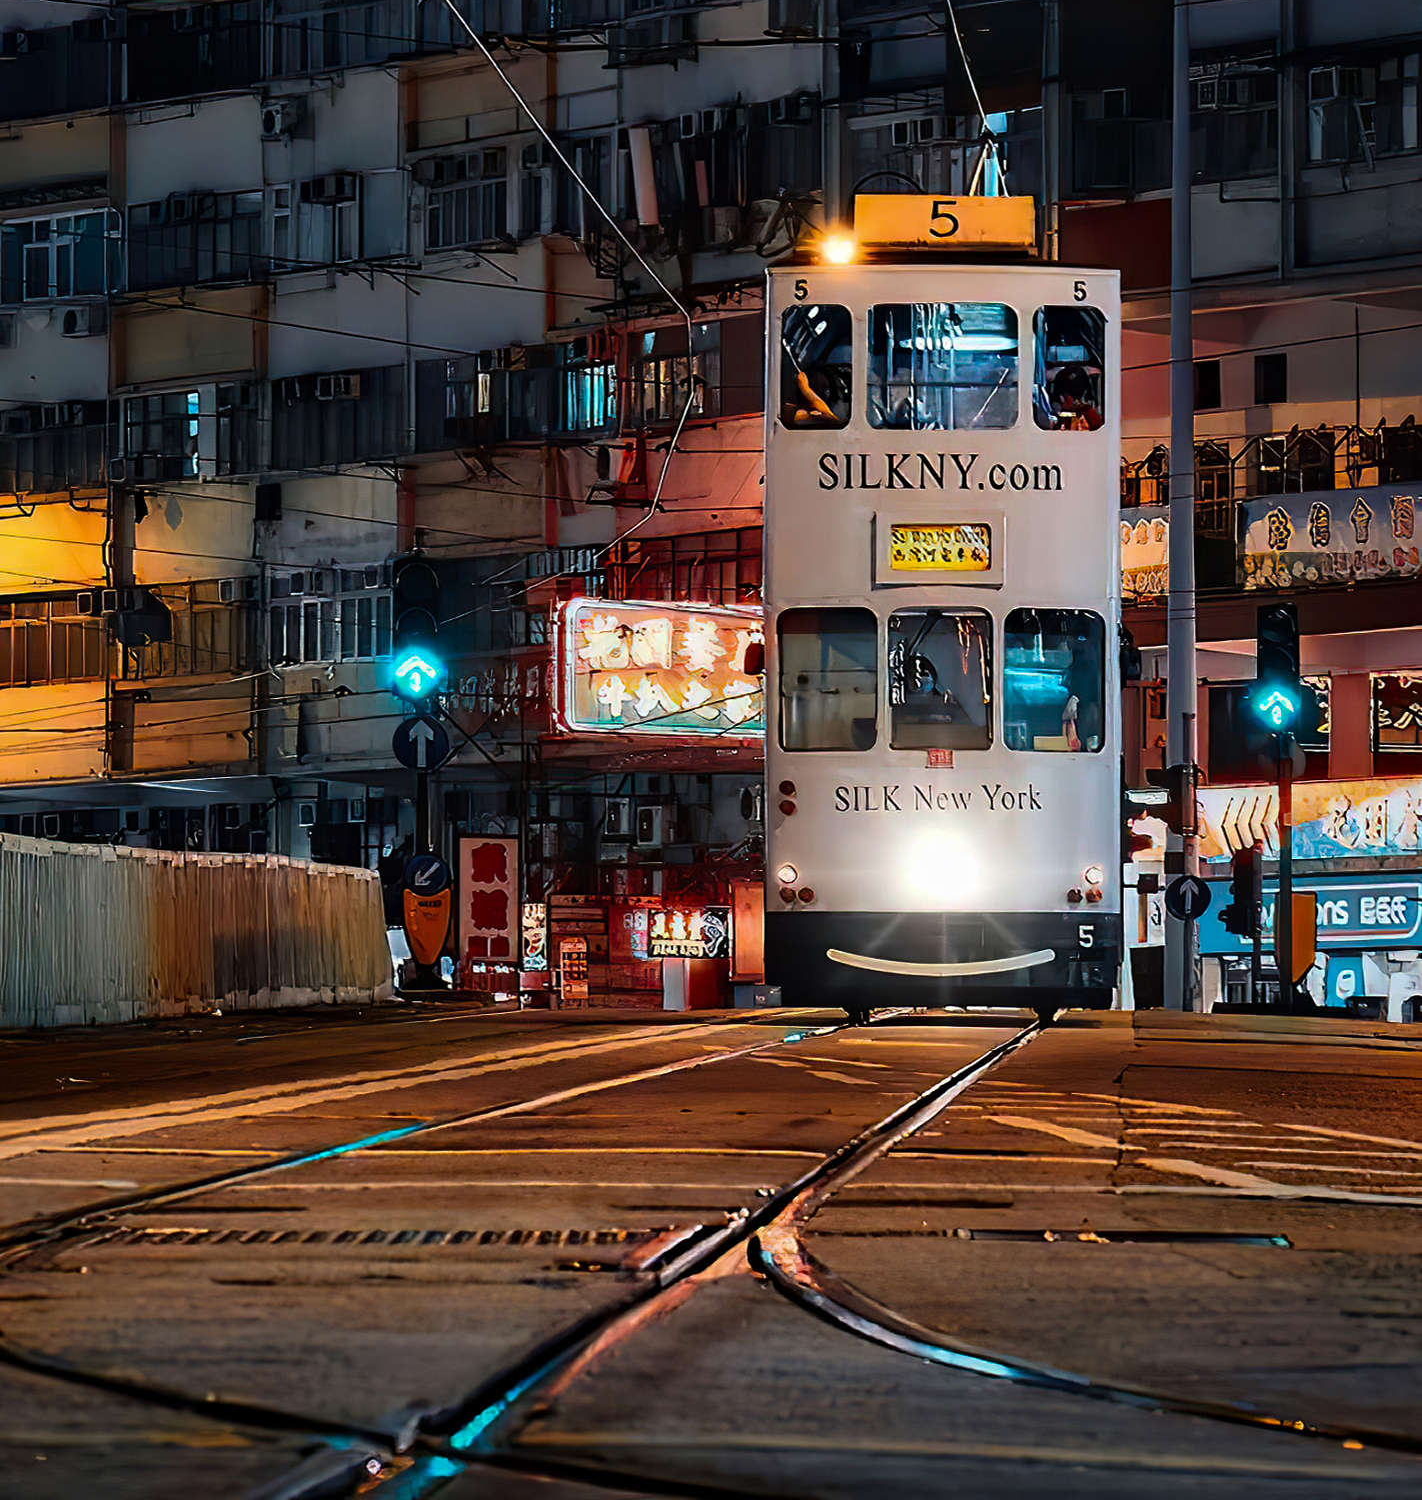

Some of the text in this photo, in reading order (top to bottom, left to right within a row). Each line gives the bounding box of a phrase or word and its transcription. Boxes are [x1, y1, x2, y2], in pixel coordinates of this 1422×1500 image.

[929, 200, 959, 238] 5
[794, 279, 809, 300] 5
[1073, 280, 1087, 302] 5
[818, 452, 1062, 491] SILKNY.com
[835, 784, 1042, 812] SILK New York
[1078, 925, 1094, 948] 5
